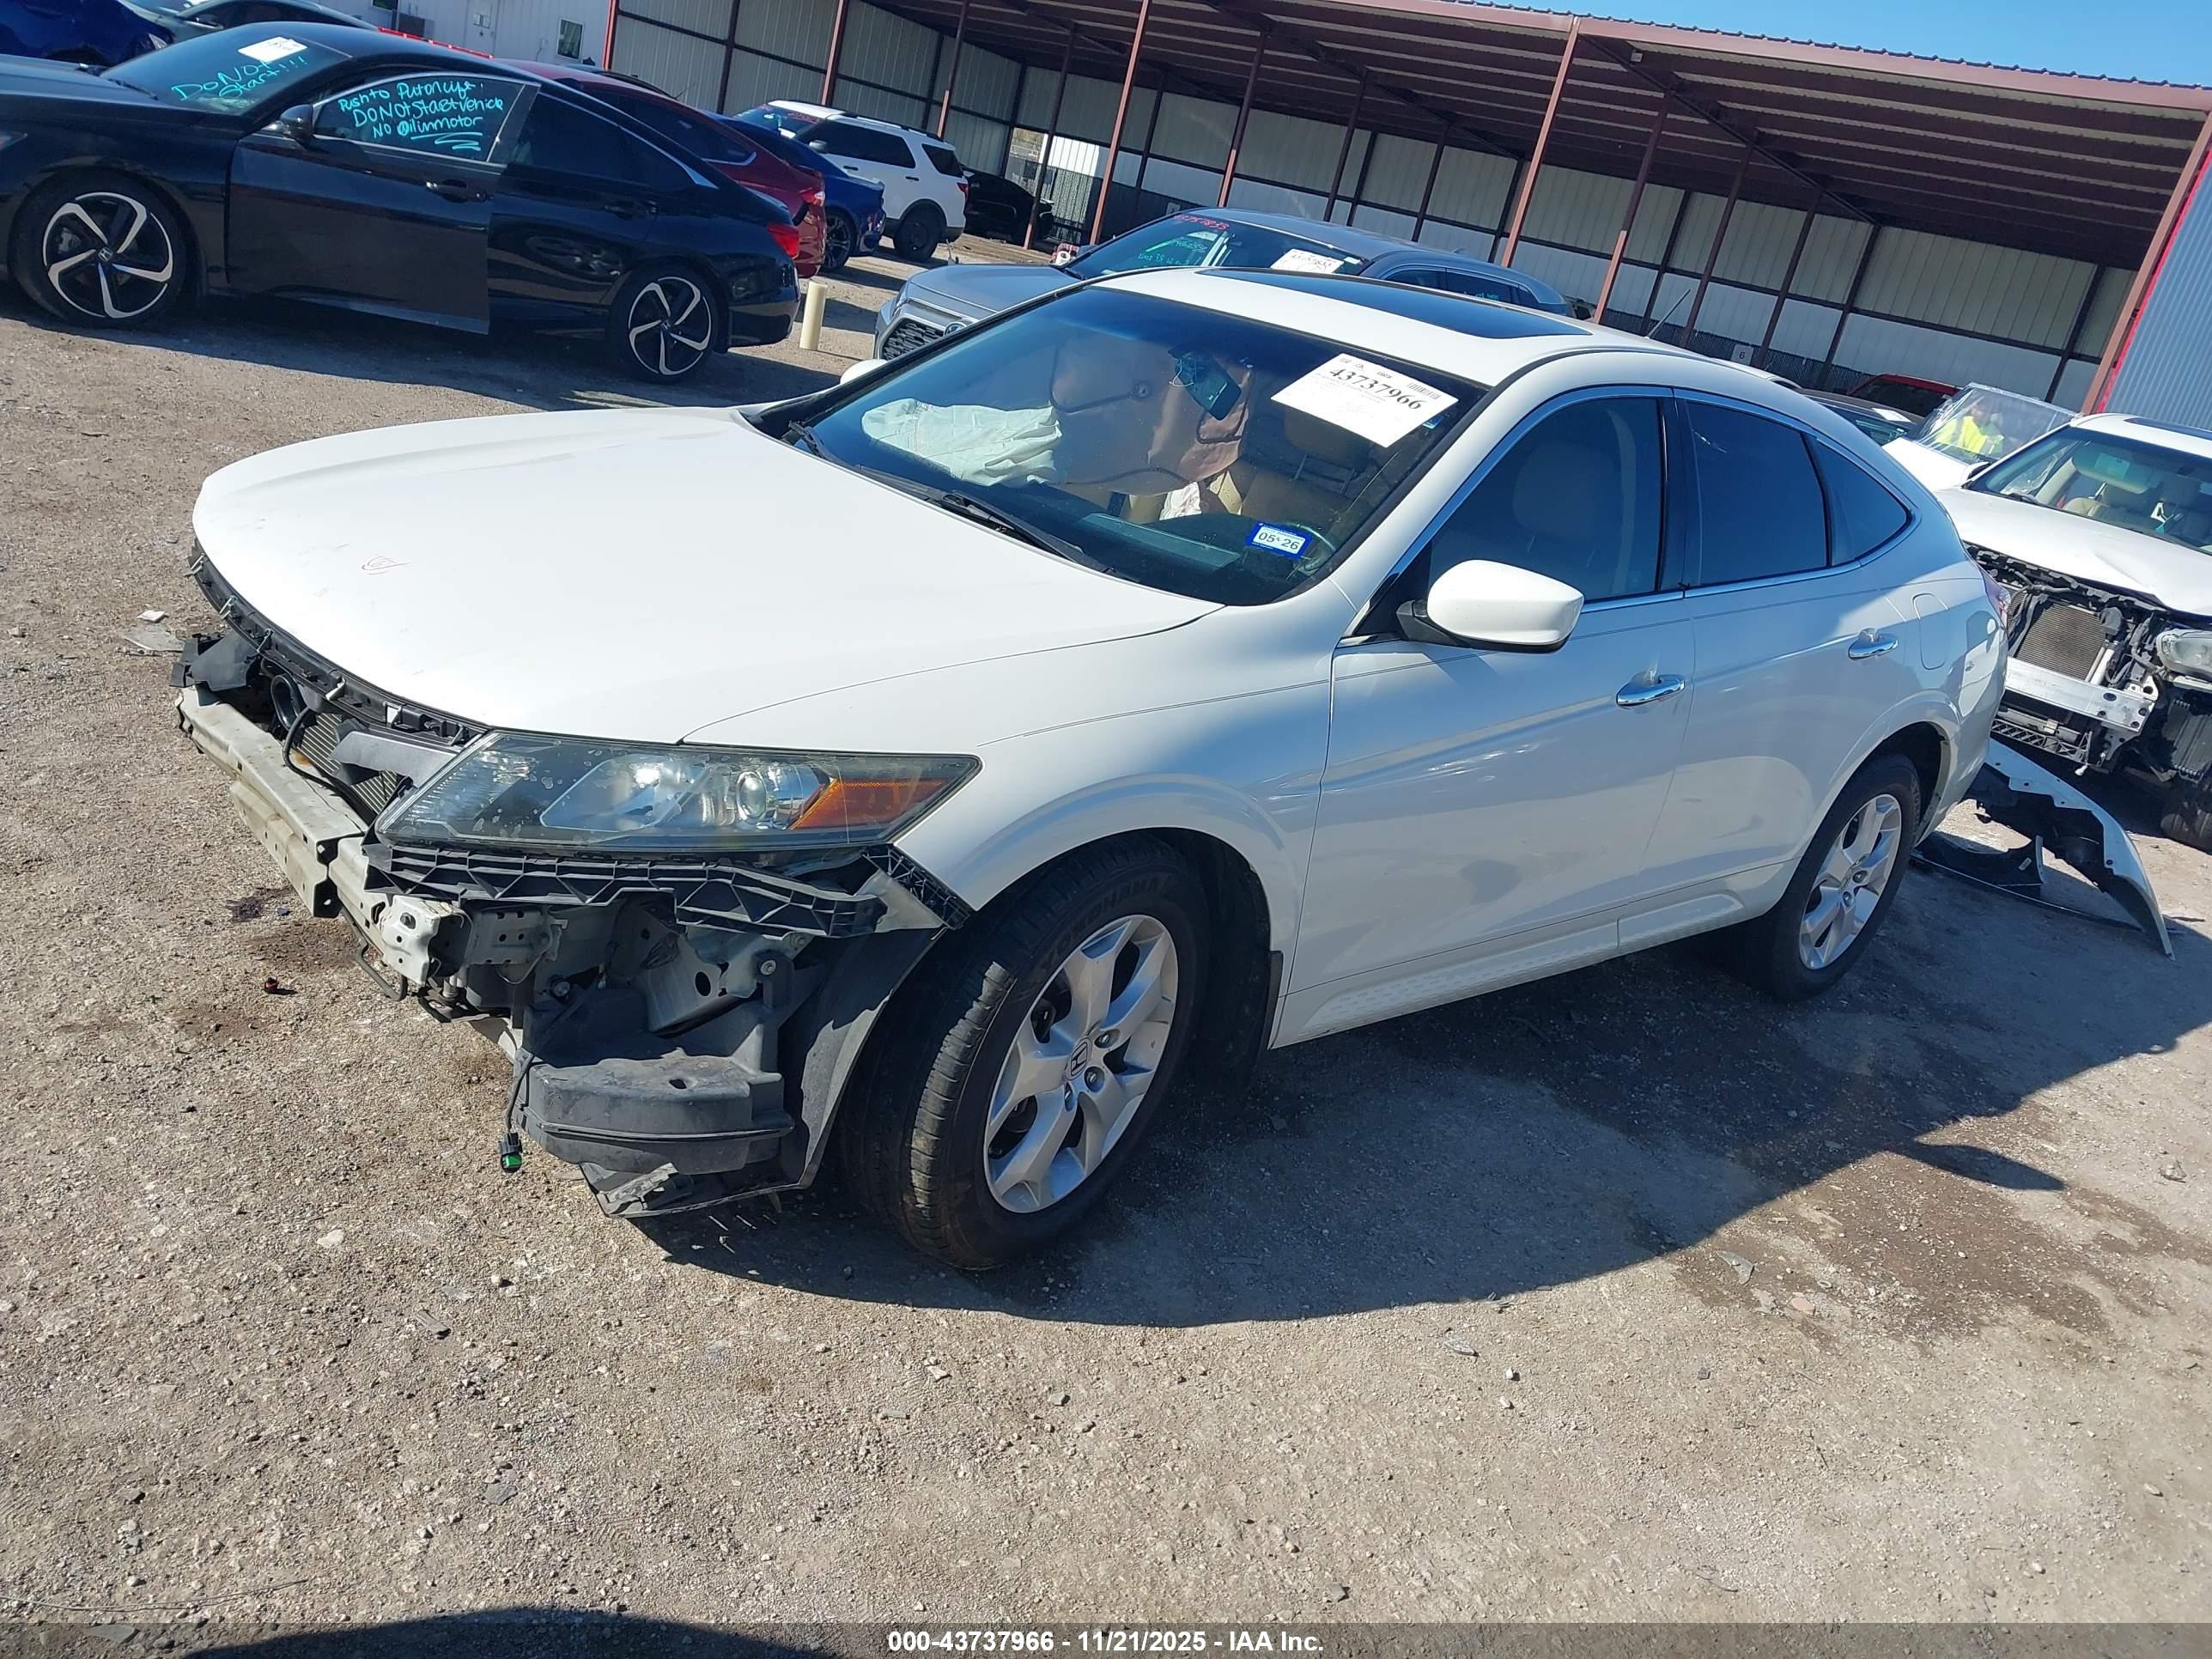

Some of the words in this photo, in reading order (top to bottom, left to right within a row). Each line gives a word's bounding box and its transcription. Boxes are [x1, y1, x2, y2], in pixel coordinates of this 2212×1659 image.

[1328, 367, 1427, 410] 43737966
[1258, 532, 1277, 544] 05
[1281, 538, 1301, 550] 26
